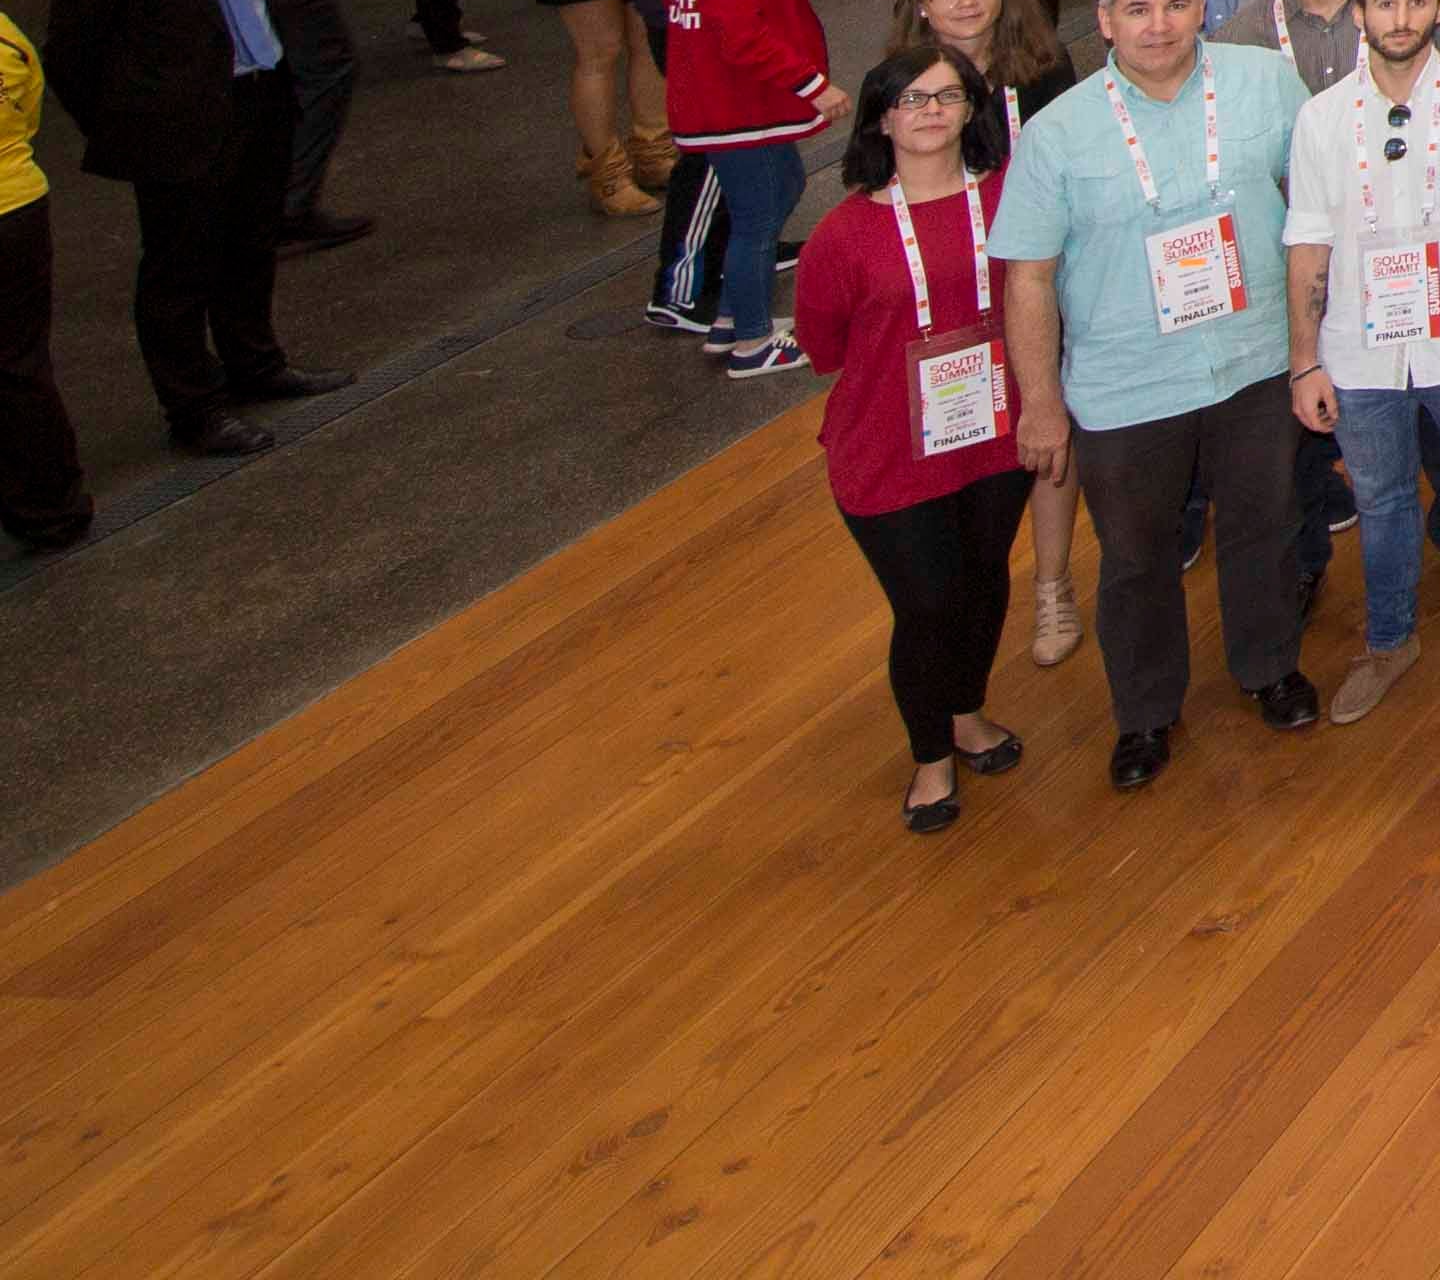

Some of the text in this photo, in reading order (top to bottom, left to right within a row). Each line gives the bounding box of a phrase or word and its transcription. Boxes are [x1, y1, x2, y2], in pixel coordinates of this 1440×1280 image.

[1173, 302, 1225, 325] FINALIST
[1375, 326, 1424, 342] FINALIST
[933, 425, 988, 448] FINALIST
